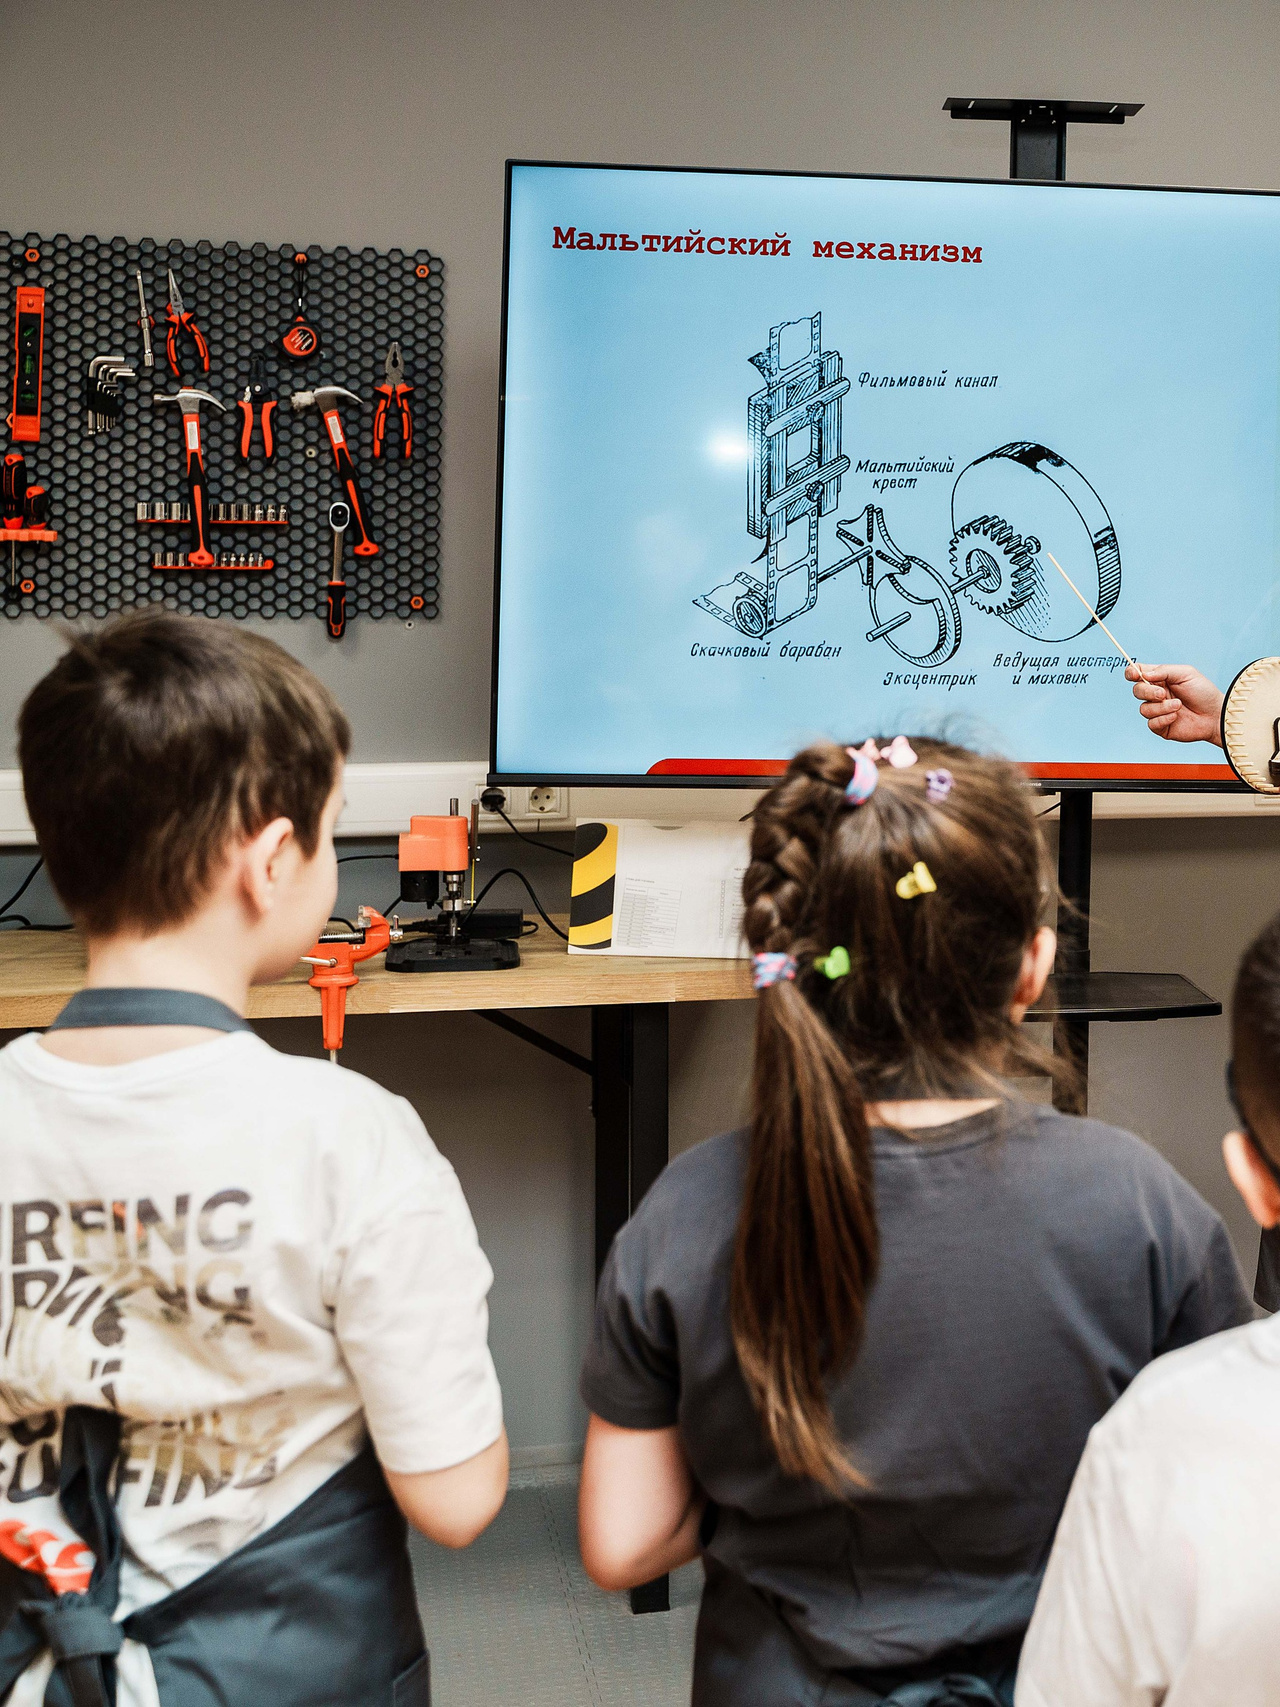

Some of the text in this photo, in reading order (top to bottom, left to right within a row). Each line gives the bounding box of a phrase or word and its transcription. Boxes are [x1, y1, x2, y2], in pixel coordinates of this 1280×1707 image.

[552, 226, 983, 264] Мальтийский механизм
[858, 370, 999, 388] Фильмовый канал
[855, 456, 955, 474] Мальтийский
[872, 477, 918, 494] крест
[690, 640, 843, 662] Скачковый барабан
[992, 651, 1060, 673] Ведущая
[882, 671, 978, 692] Эксцентрик
[1012, 673, 1089, 685] и маховик
[0, 1188, 255, 1266] RFING
